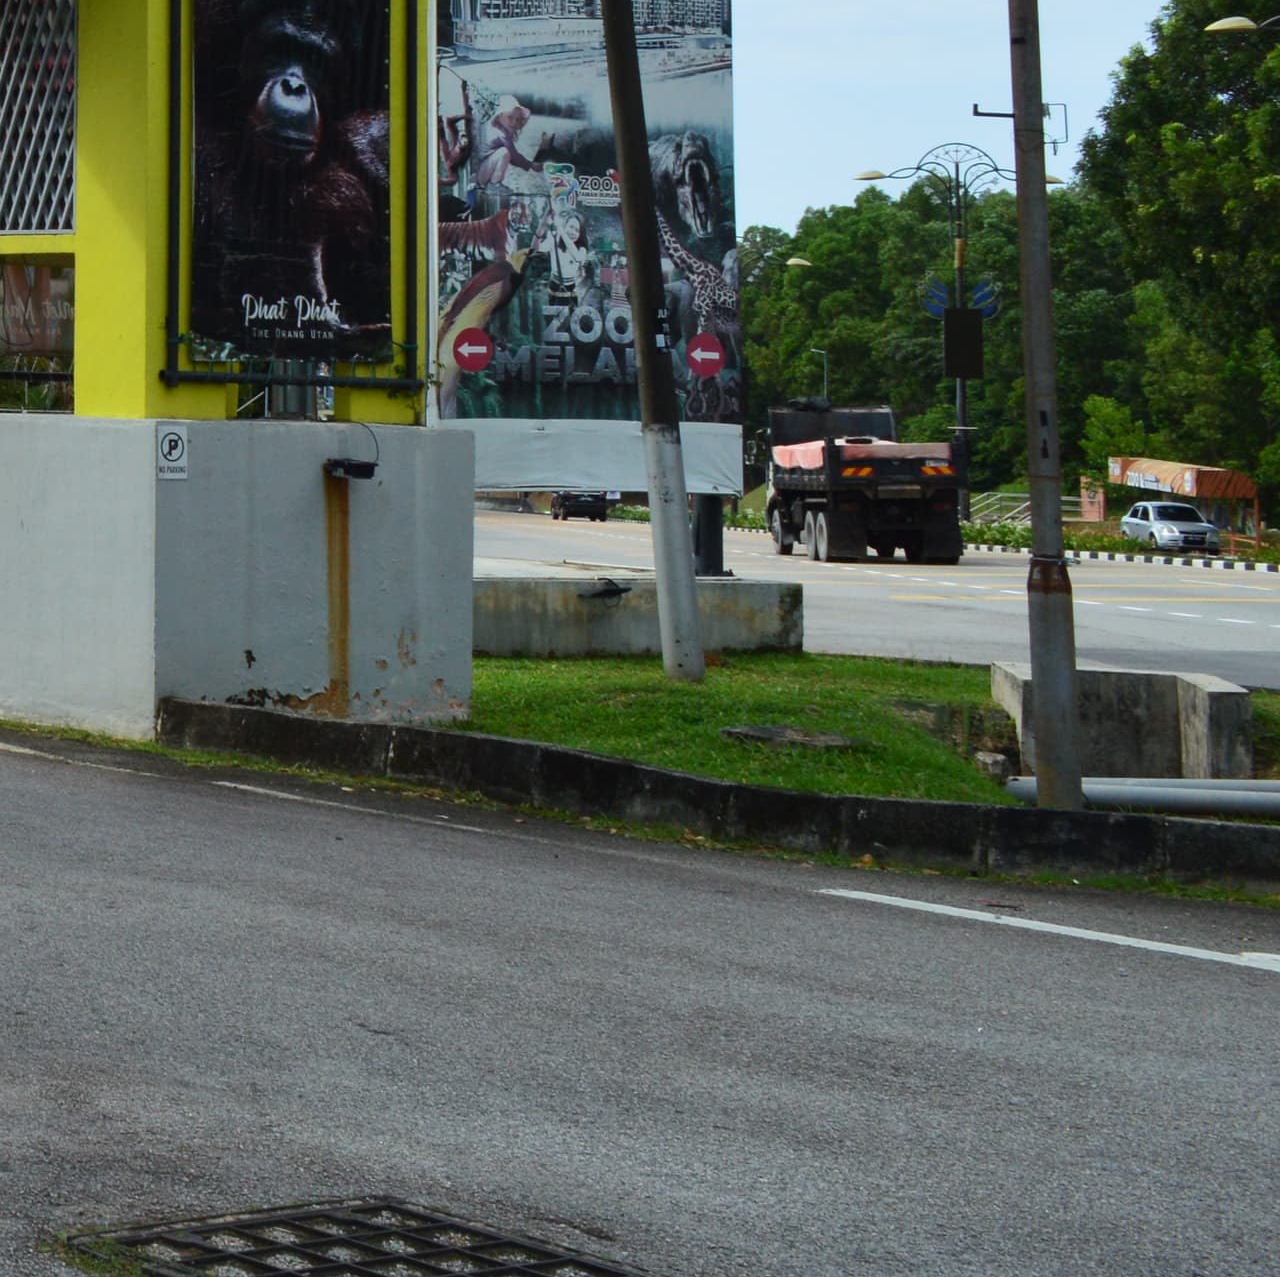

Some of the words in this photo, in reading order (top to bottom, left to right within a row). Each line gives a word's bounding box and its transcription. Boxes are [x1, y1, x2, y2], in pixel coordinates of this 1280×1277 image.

[579, 176, 614, 192] ZOO
[241, 293, 288, 327] Phat
[294, 295, 341, 328] Phat
[542, 305, 634, 345] ZOO
